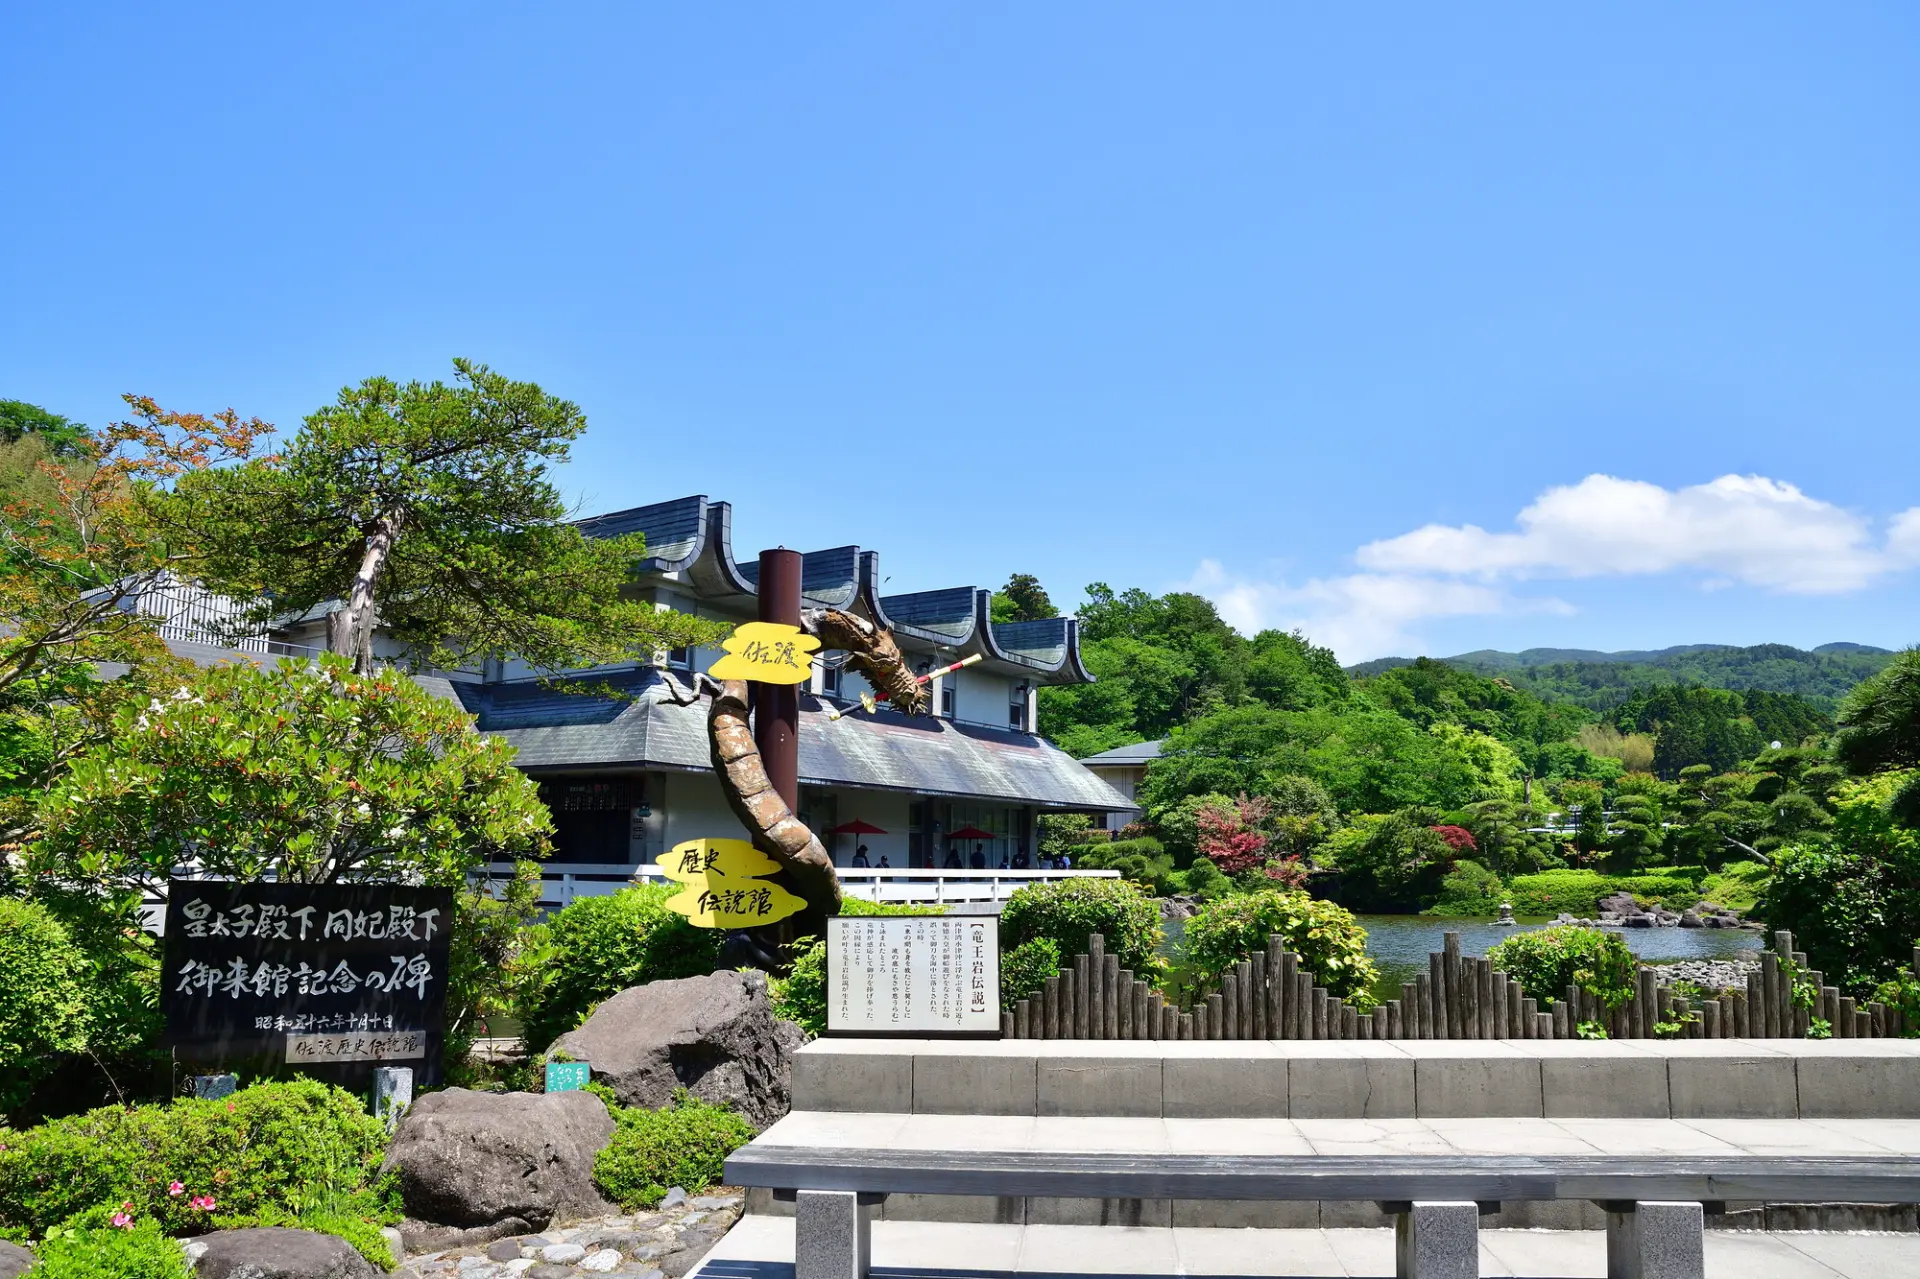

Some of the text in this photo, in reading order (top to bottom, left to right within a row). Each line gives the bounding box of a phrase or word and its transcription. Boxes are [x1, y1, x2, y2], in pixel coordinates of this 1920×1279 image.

[742, 641, 799, 669] 佐渡
[678, 849, 725, 876] 歴史
[697, 889, 773, 916] 伝説館
[176, 952, 434, 1000] 御来館記念の碑
[255, 1012, 393, 1031] 昭和五十六年十月十日
